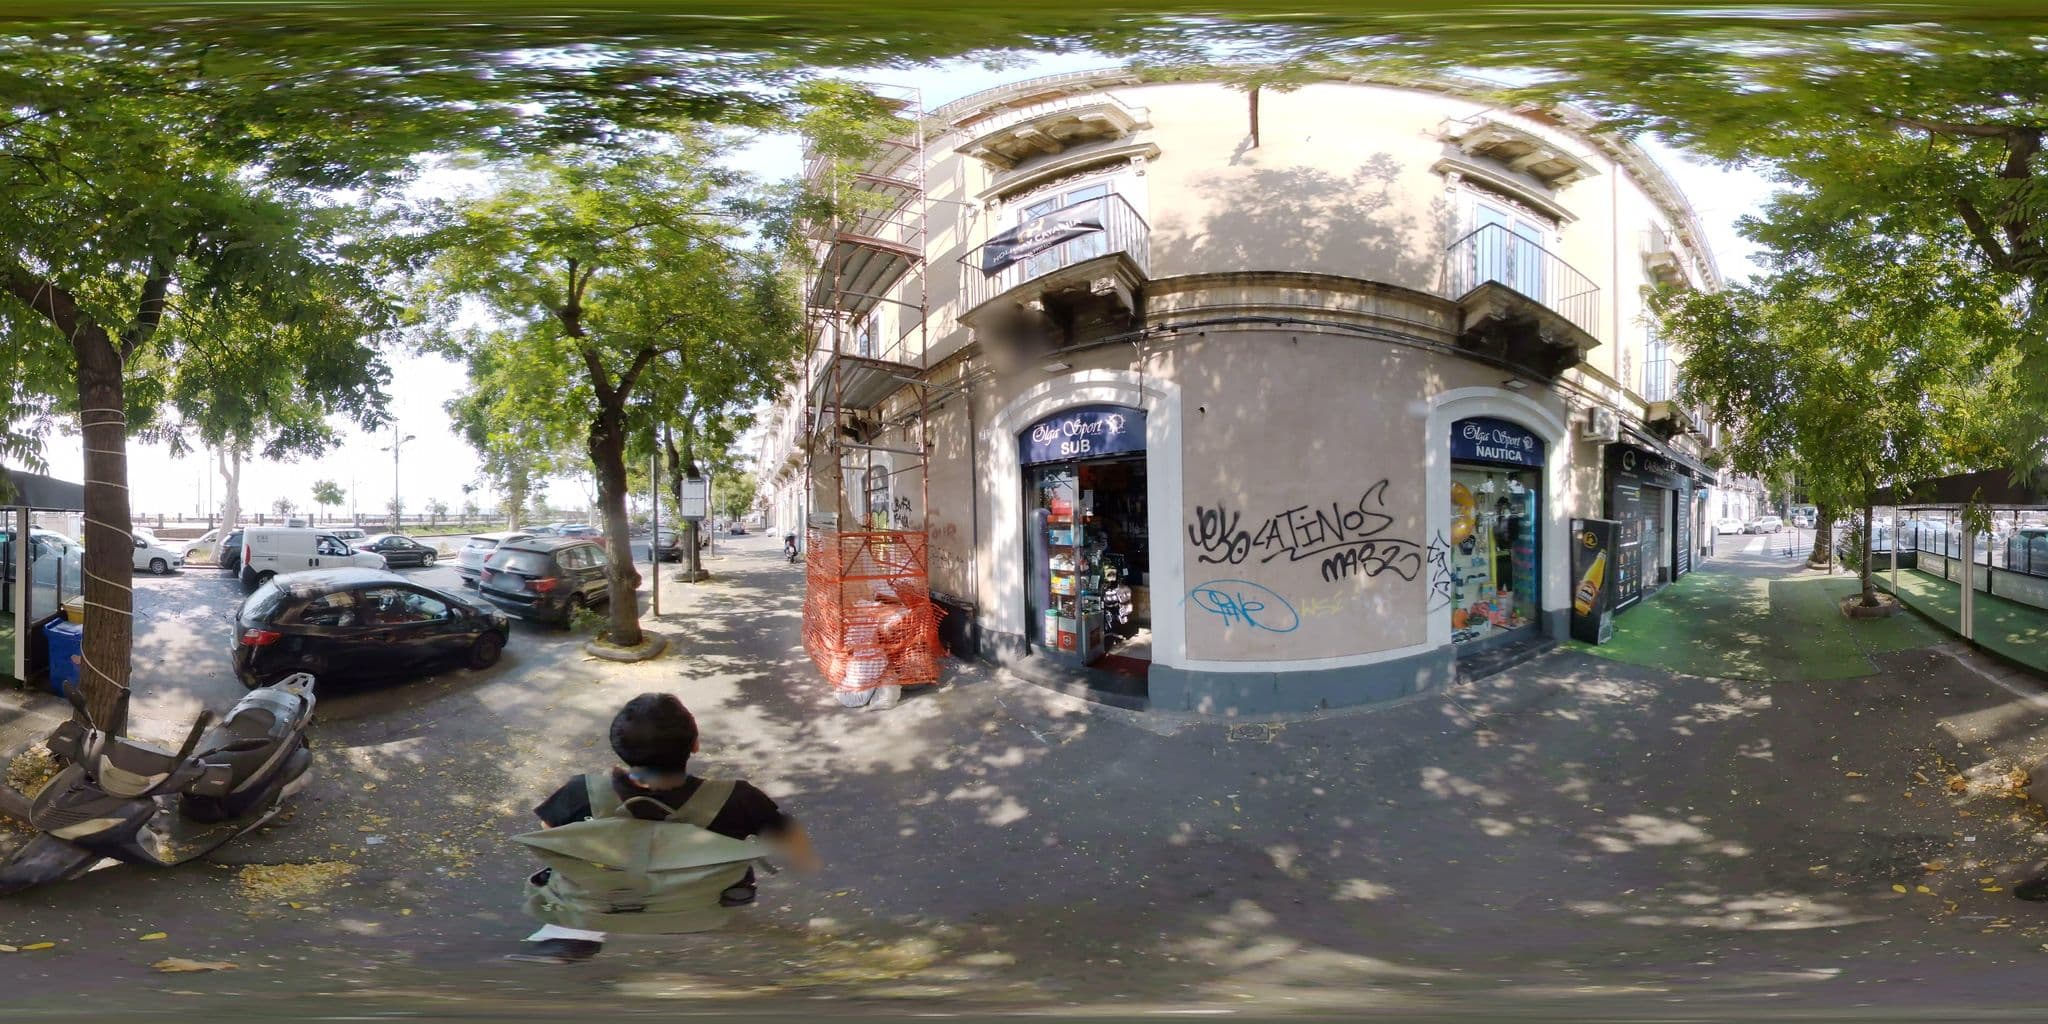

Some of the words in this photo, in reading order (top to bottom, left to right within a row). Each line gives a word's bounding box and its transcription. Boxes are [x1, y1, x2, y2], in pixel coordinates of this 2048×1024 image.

[1032, 426, 1060, 446] Olga
[1063, 419, 1104, 439] Sport
[1463, 425, 1490, 445] Olga
[1492, 429, 1521, 448] Sport
[1061, 439, 1091, 455] SUB
[1475, 445, 1522, 461] NAUTICA
